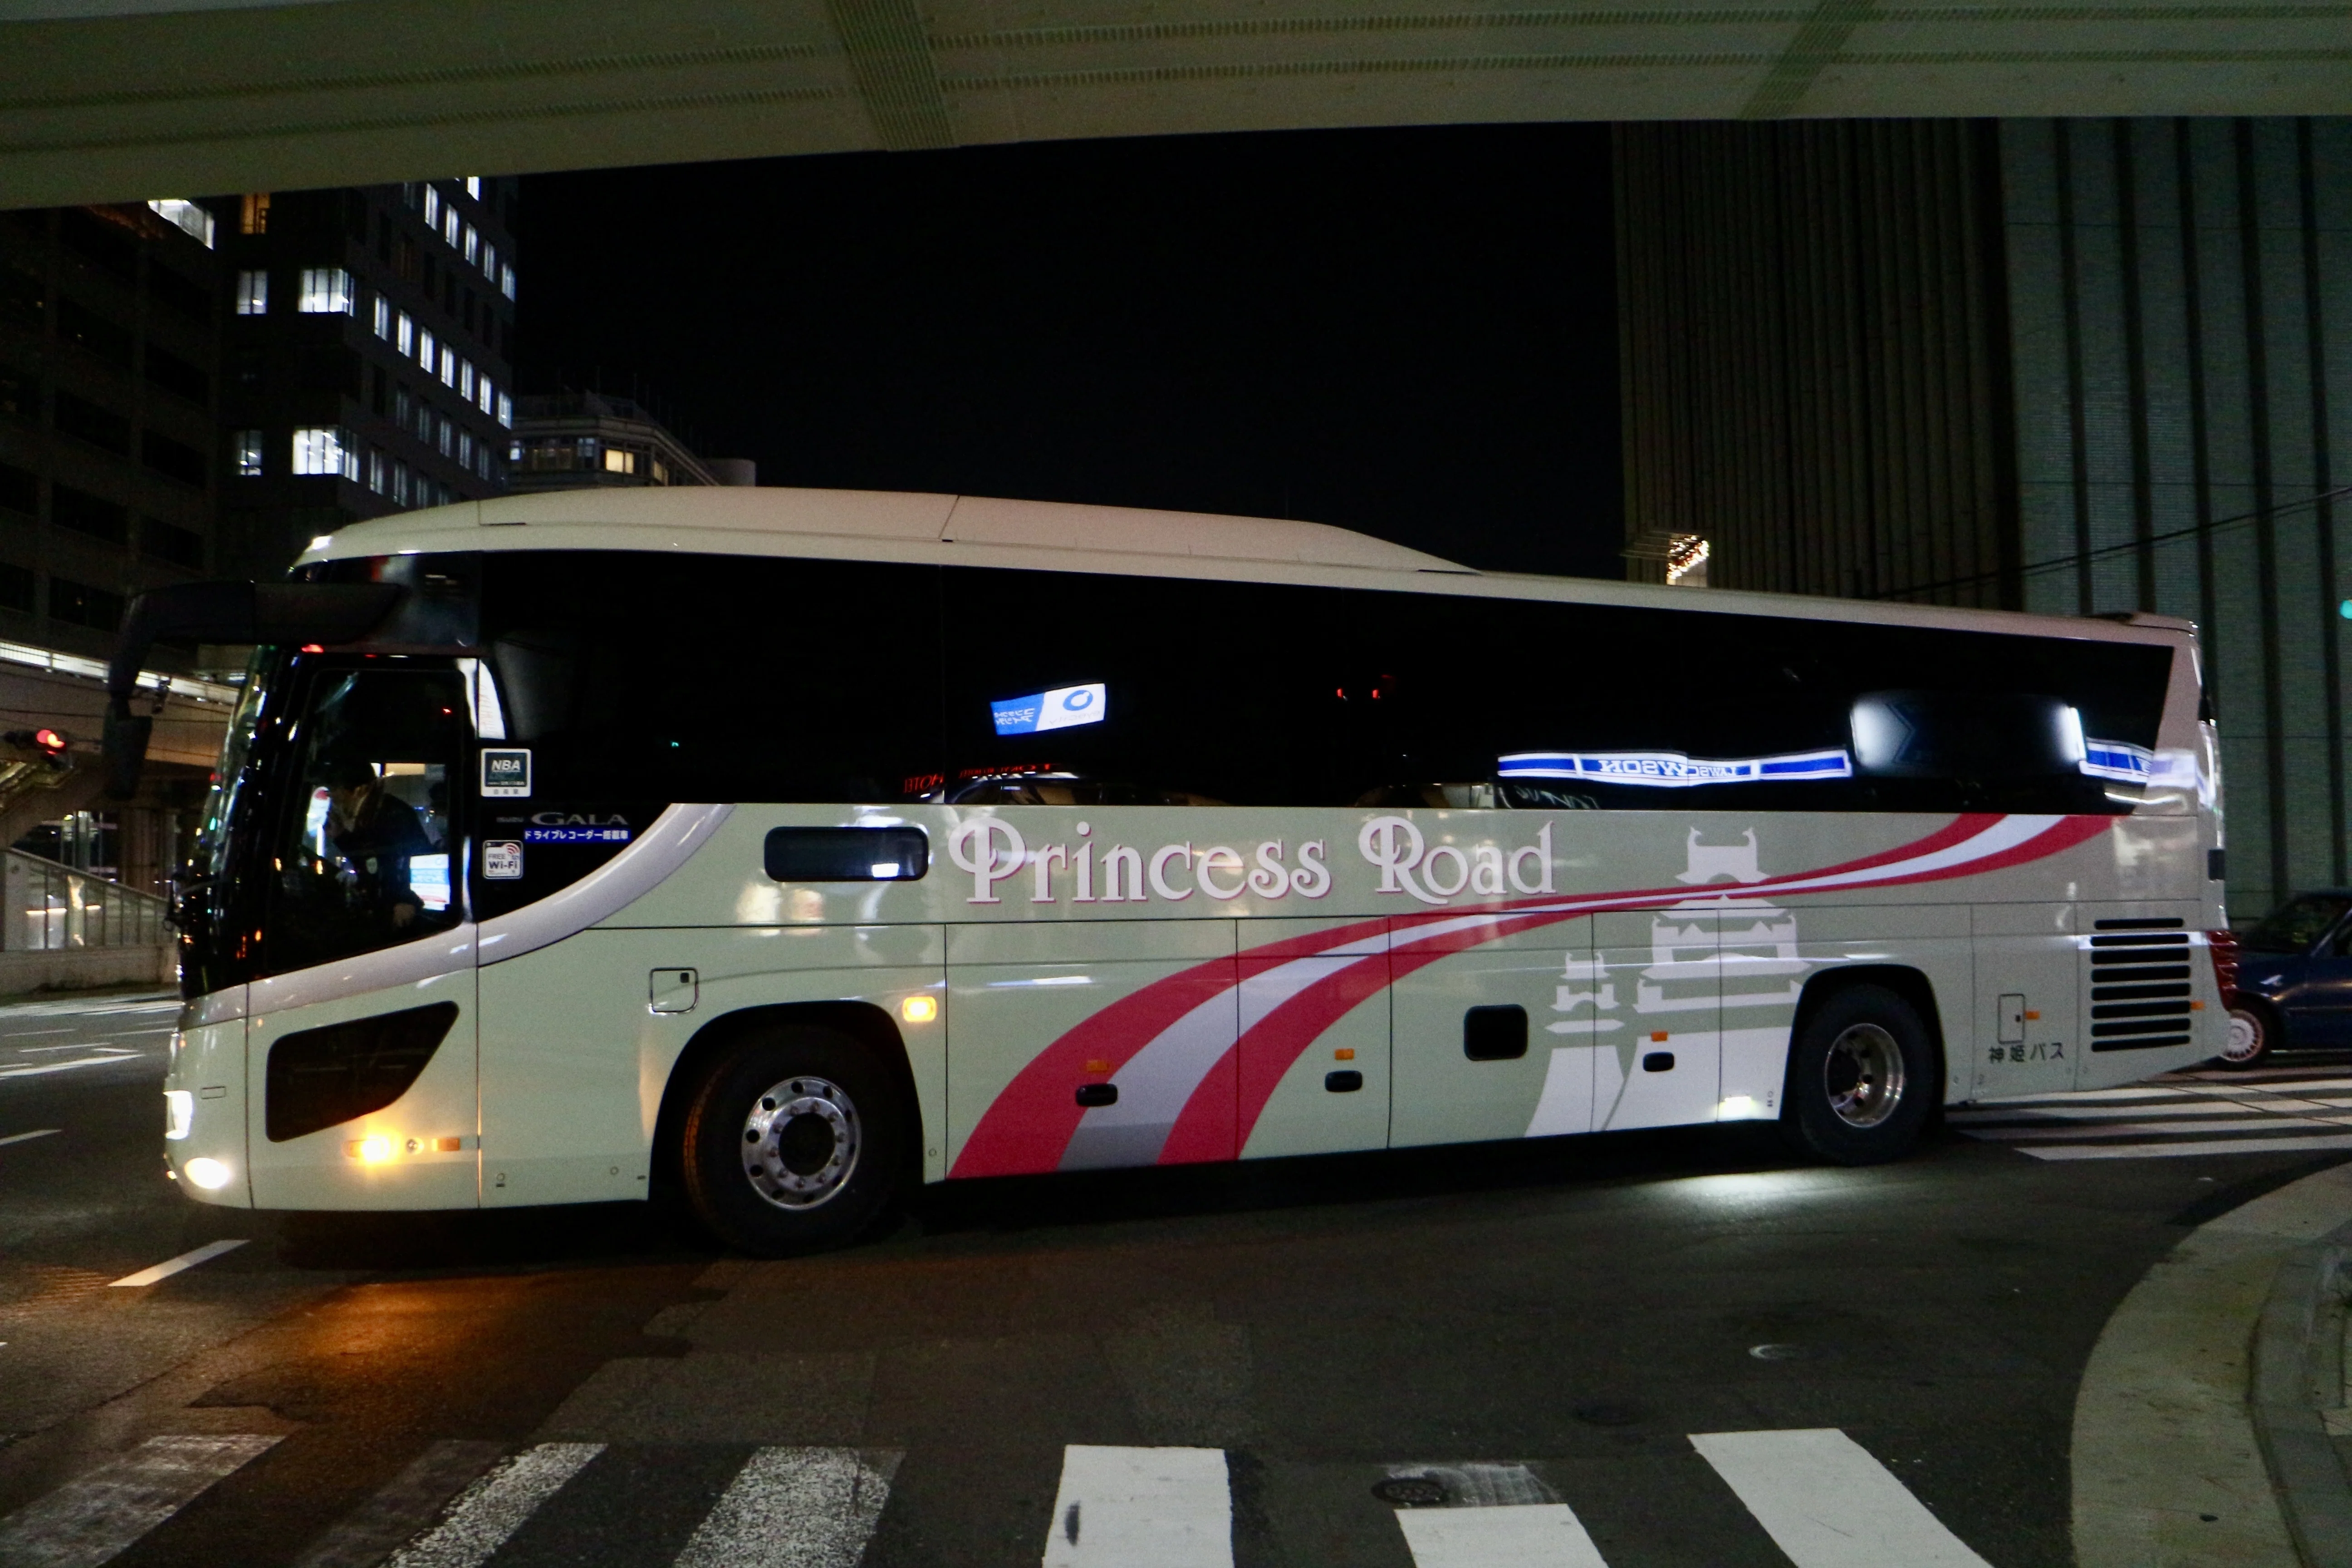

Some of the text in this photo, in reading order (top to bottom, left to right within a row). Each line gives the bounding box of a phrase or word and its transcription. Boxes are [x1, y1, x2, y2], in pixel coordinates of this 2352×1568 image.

[491, 760, 521, 771] NBA
[530, 812, 629, 825] GALA
[948, 816, 1557, 905] Princess Road
[1989, 1042, 2064, 1063] 神姫バス
